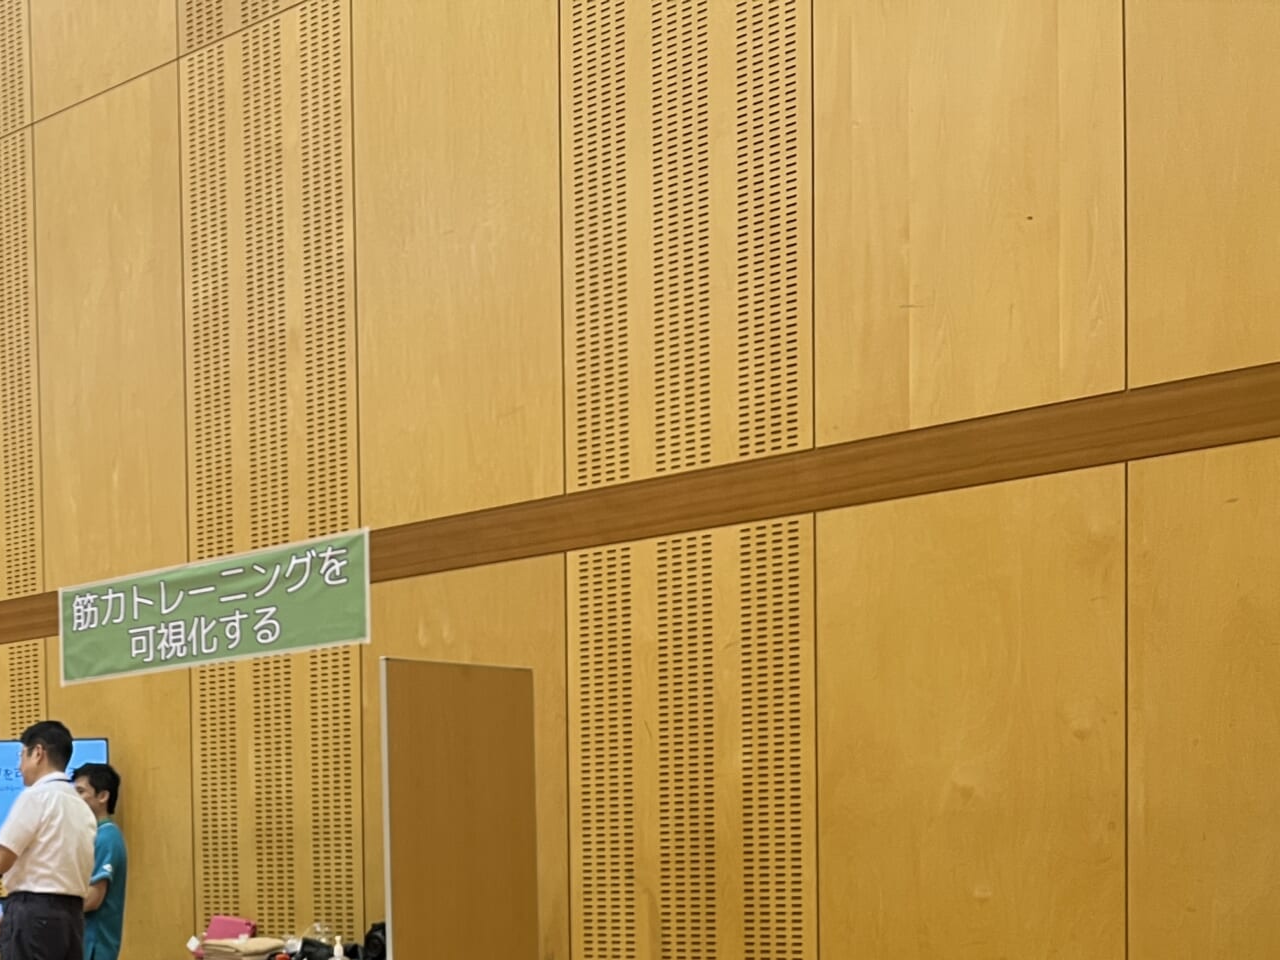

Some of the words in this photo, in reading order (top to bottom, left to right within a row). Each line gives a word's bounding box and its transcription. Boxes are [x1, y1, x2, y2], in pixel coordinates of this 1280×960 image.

[71, 545, 349, 632] 筋力トレーニングを
[127, 605, 281, 662] 可視化する
